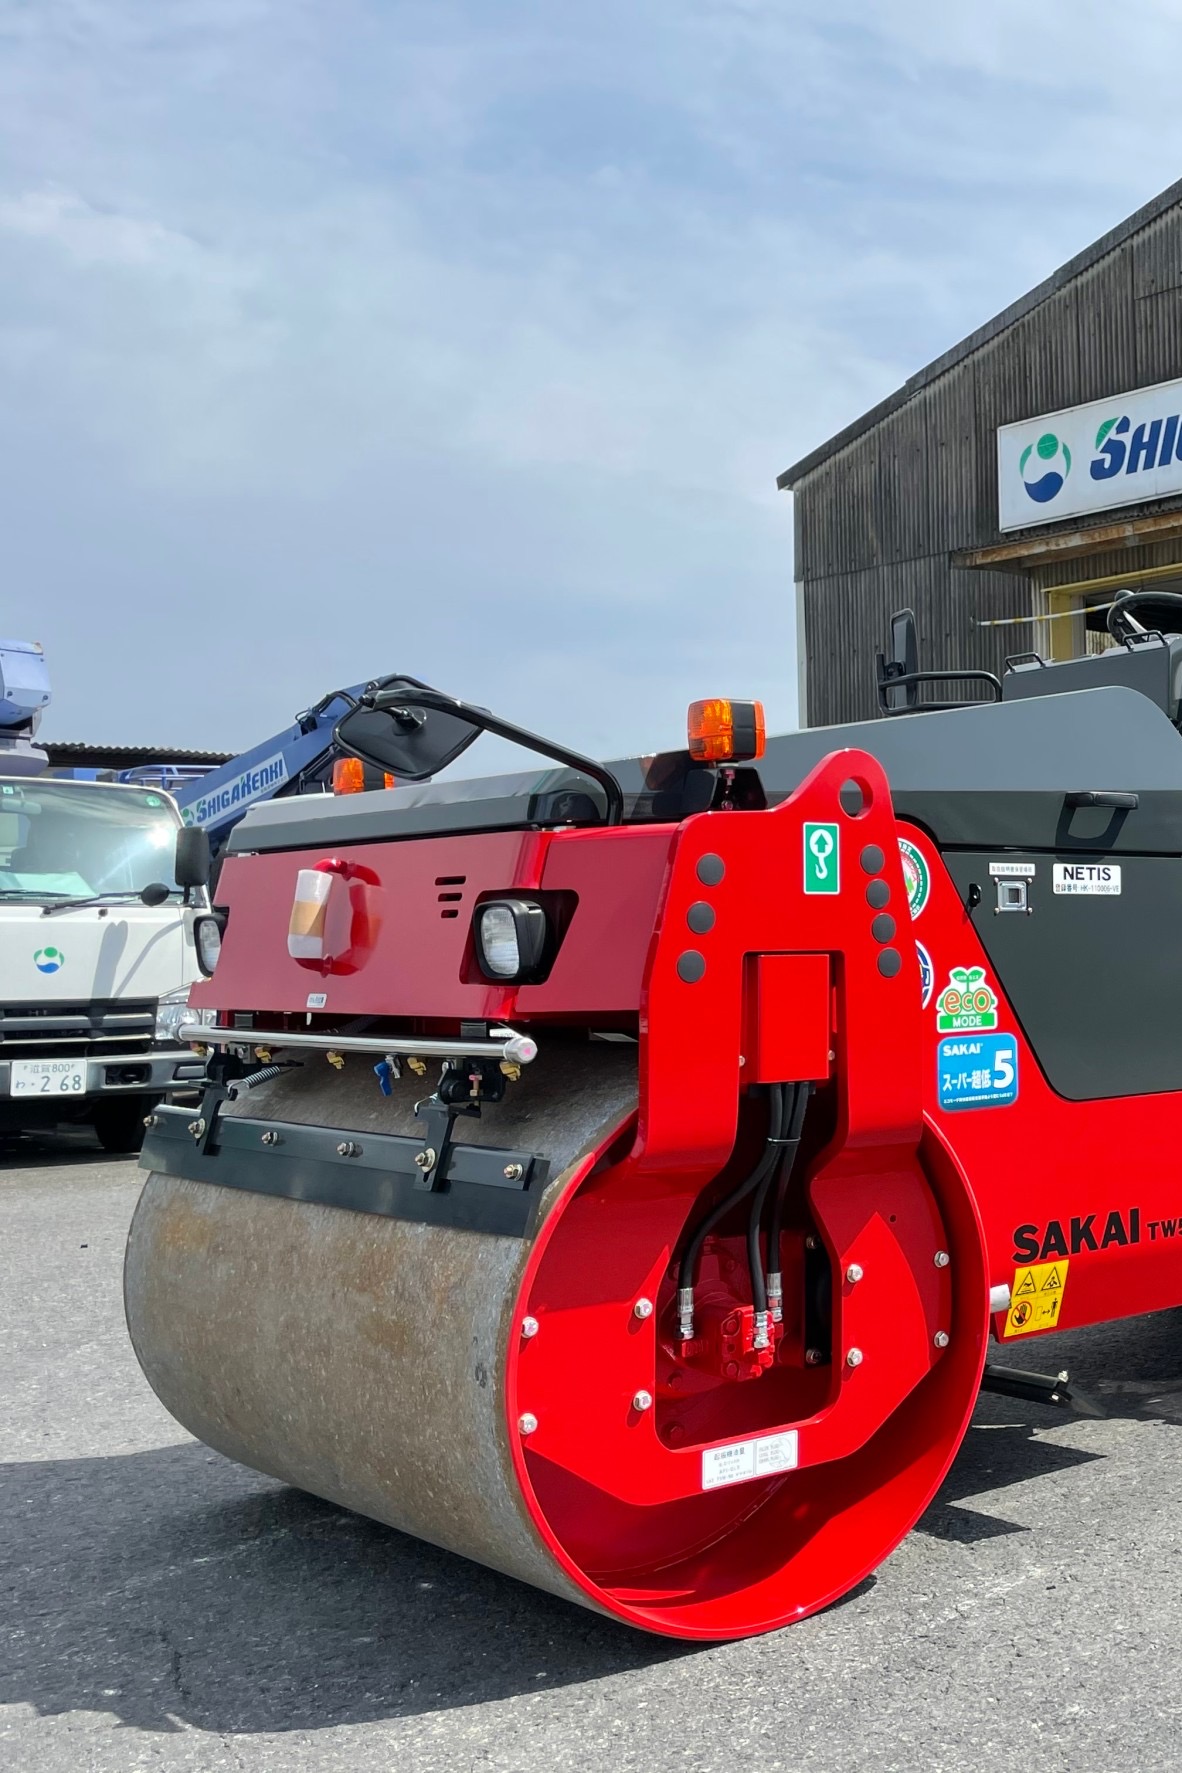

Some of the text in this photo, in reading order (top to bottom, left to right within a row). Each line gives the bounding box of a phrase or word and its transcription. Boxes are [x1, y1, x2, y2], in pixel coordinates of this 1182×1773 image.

[196, 758, 284, 823] SHIGAKENKI
[1063, 866, 1112, 881] NETIS
[943, 988, 991, 1016] eco
[952, 1015, 983, 1028] MODE
[943, 1042, 982, 1057] SAKAI
[993, 1049, 1015, 1089] 5
[1012, 1207, 1140, 1264] SAKAI
